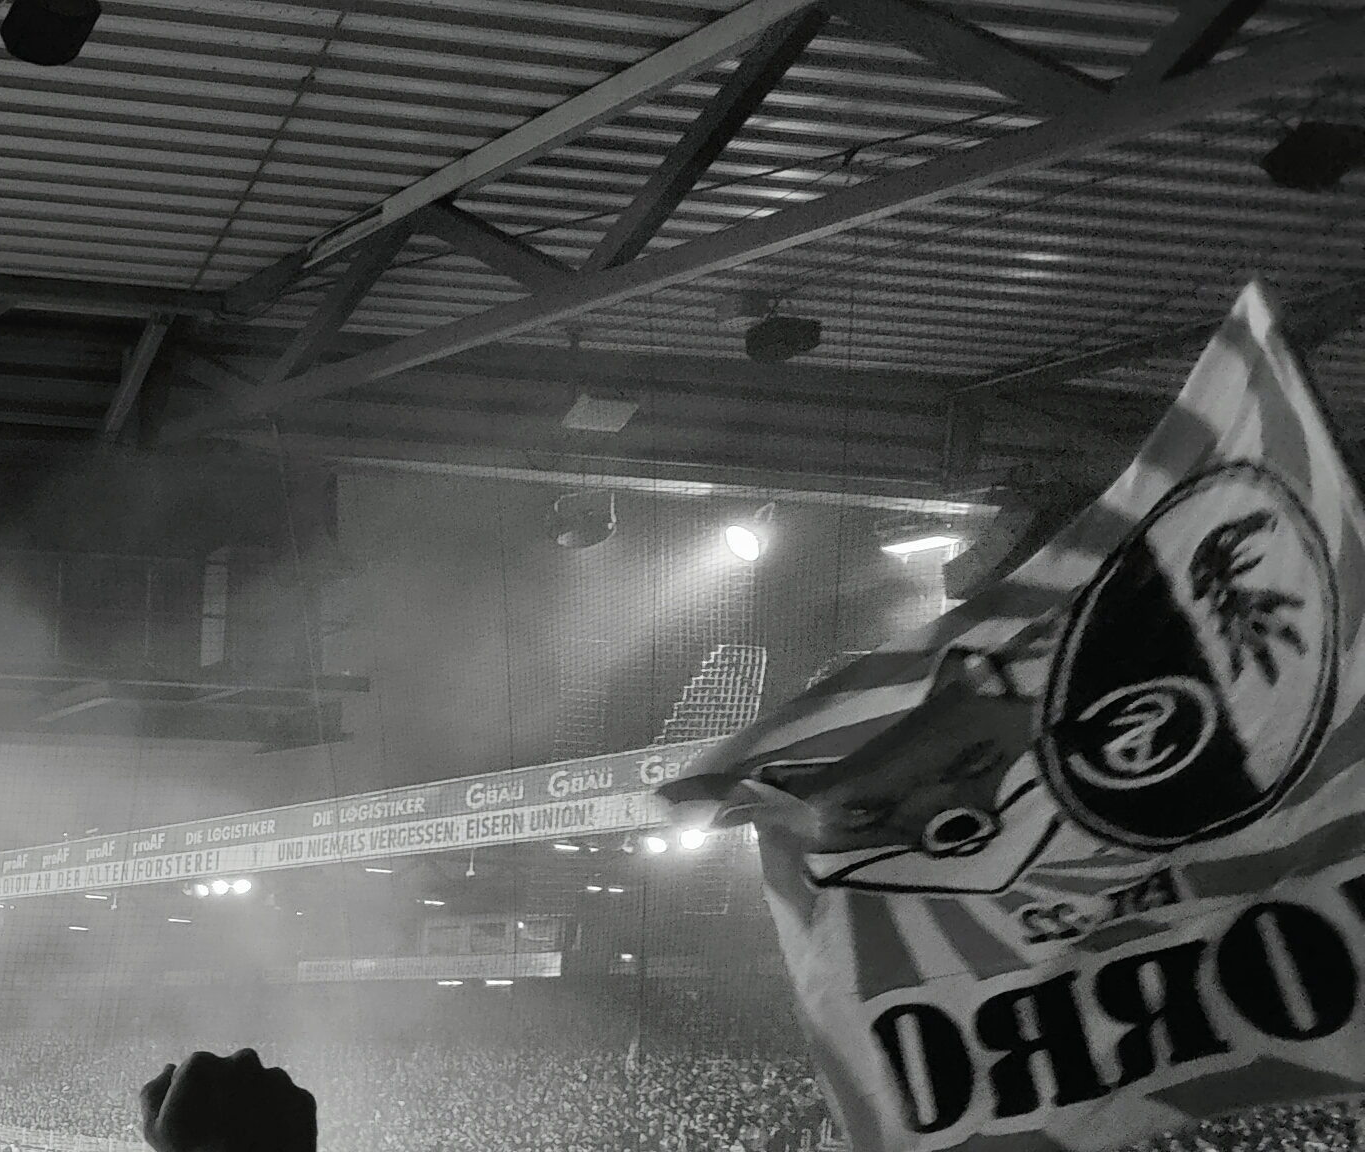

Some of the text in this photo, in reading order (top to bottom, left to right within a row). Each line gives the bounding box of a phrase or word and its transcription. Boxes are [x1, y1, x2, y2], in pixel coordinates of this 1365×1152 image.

[312, 797, 426, 828] DIE LOGISTIKER
[132, 832, 166, 857] proAF
[185, 819, 276, 846] DIE LOGISTIKER
[277, 843, 304, 863] UND
[307, 832, 366, 859] NIEMALS
[466, 812, 525, 840] EISERN
[85, 841, 116, 863] proAF
[35, 873, 51, 892] AN
[58, 869, 81, 888] DER
[87, 862, 130, 886] ALTEN
